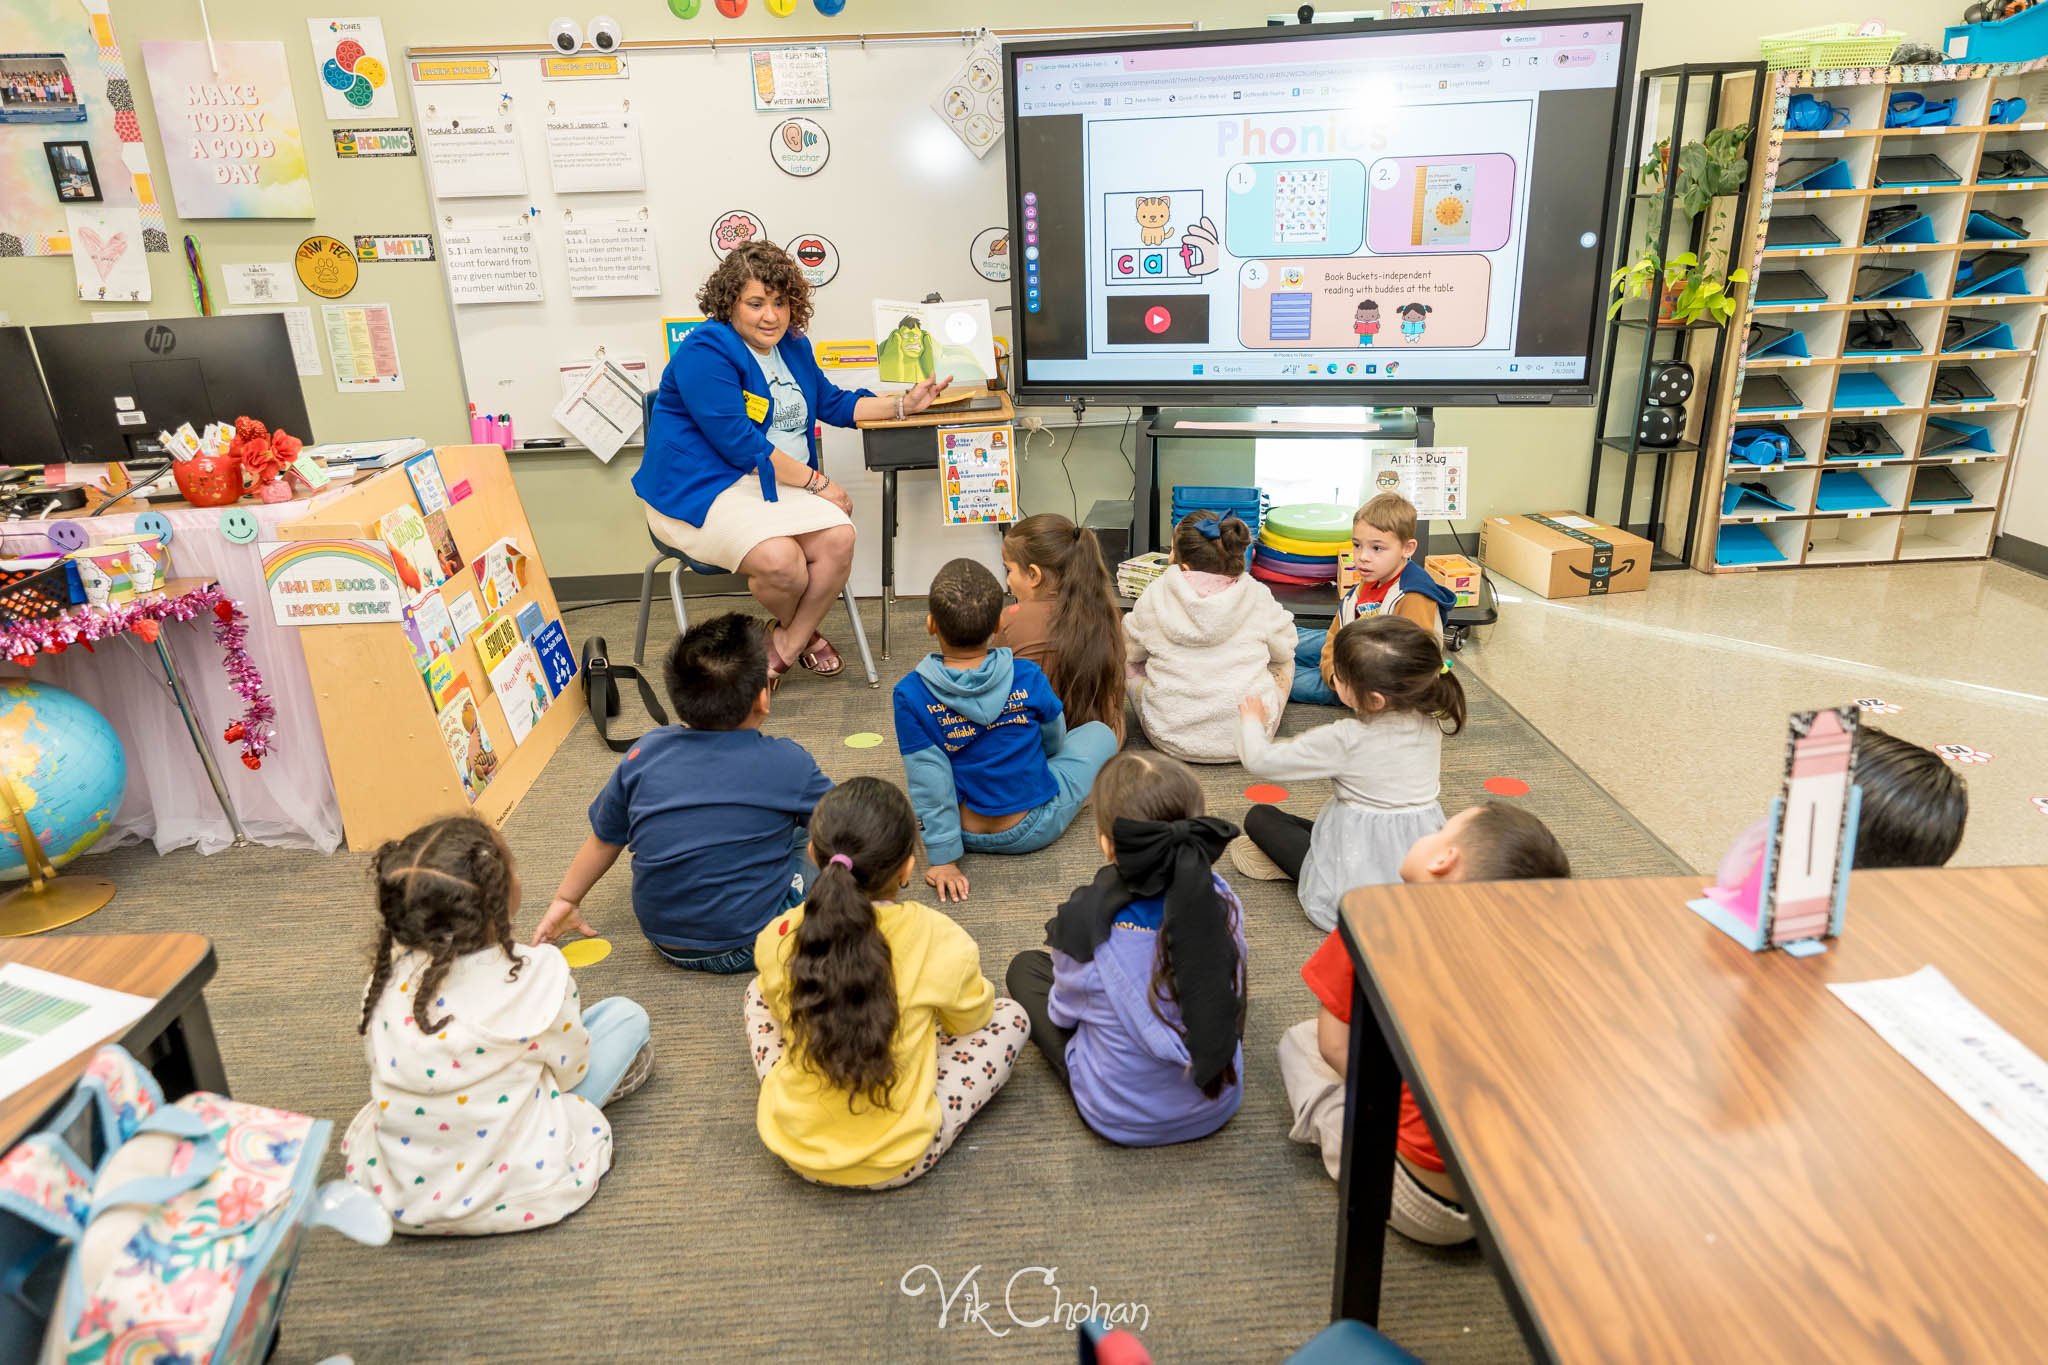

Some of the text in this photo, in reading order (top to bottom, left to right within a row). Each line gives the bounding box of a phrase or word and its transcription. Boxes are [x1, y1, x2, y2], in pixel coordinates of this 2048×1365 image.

[185, 84, 260, 106] MAKE
[186, 111, 265, 133] TODAY
[427, 127, 452, 135] Module
[213, 137, 276, 159] GOOD
[358, 135, 409, 151] READING
[782, 152, 820, 162] escuchar
[215, 164, 261, 185] DAY
[790, 164, 813, 173] listen
[1379, 168, 1391, 181] 2.
[299, 240, 322, 259] PAW
[384, 240, 424, 256] MATH
[448, 247, 461, 255] 5.1
[485, 246, 518, 255] learning
[450, 257, 531, 268] count forward from
[452, 273, 467, 281] any
[470, 271, 492, 281] given
[494, 270, 527, 279] number
[1249, 268, 1260, 280] 3.
[1325, 271, 1344, 281] Book
[461, 284, 494, 293] number
[497, 282, 523, 291] within
[525, 282, 538, 291] 20.
[1324, 283, 1454, 297] reading with buddies at the table
[148, 326, 173, 354] hp
[1426, 453, 1447, 465] Rug
[279, 580, 309, 594] HMH
[311, 578, 332, 592] BIG
[335, 577, 376, 592] BOOKS
[485, 619, 515, 659] SCHOOL BUS
[503, 674, 516, 693] Went
[514, 652, 534, 676] Walking
